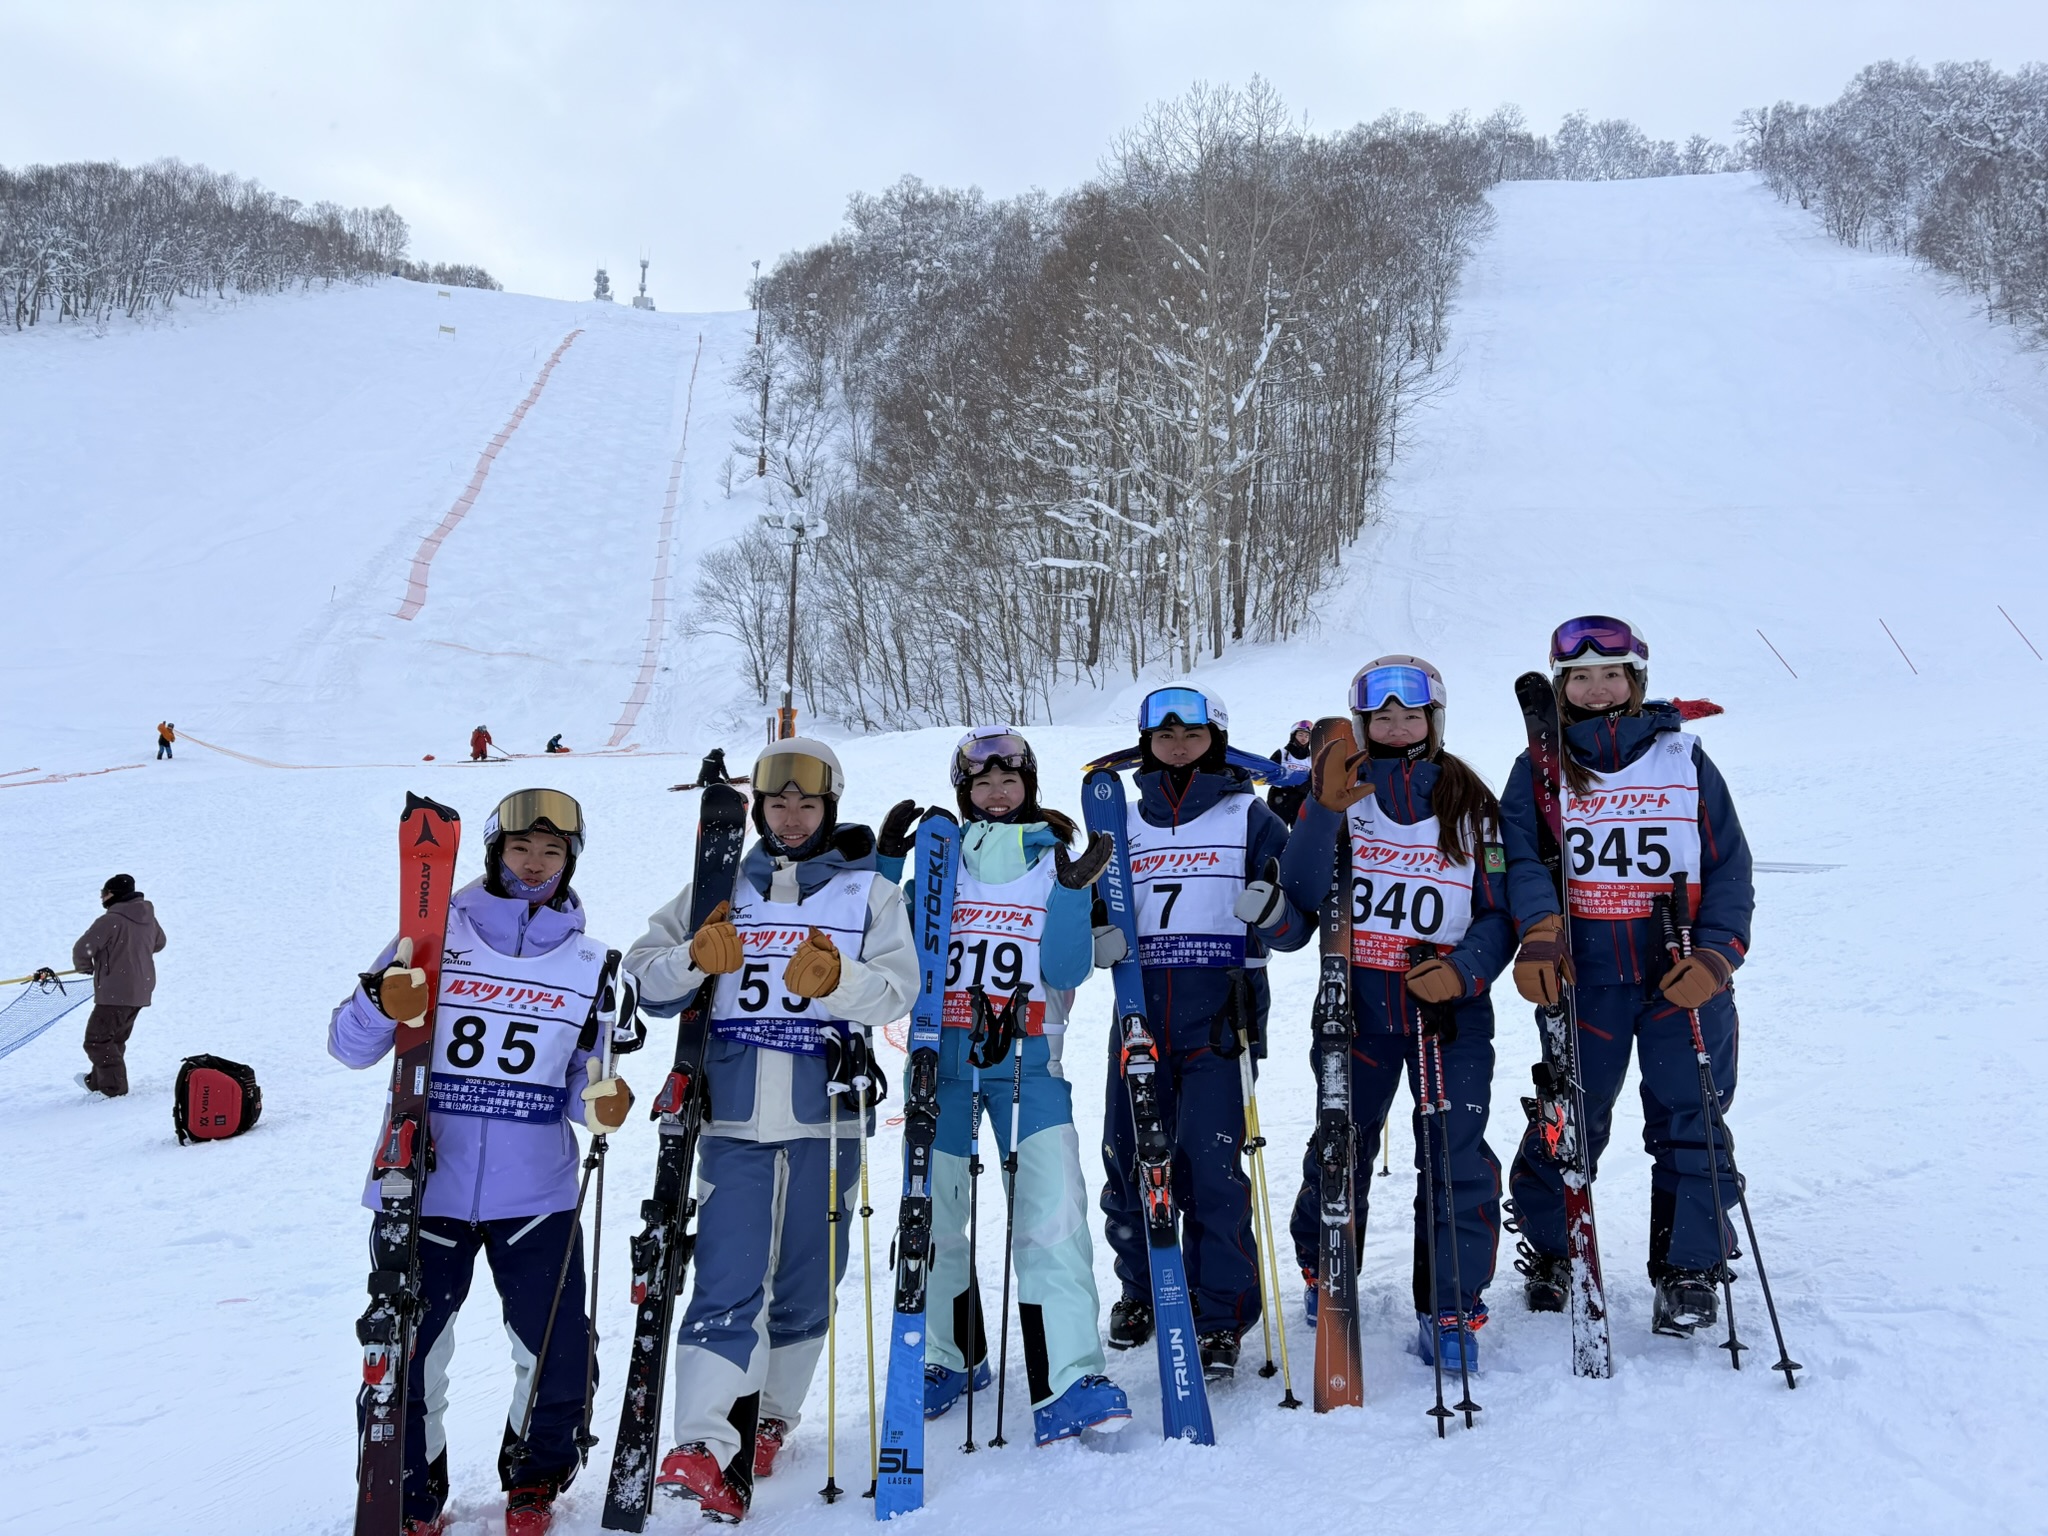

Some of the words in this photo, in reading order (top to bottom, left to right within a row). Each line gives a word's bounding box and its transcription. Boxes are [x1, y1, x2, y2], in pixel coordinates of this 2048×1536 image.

[1610, 793, 1670, 810] リゾート
[1131, 854, 1167, 875] ルスツ
[1168, 851, 1220, 867] リゾート
[1353, 845, 1400, 866] ルスツ
[1401, 852, 1450, 872] リゾート
[1565, 826, 1671, 877] 345
[418, 861, 431, 919] ATOMIC
[924, 832, 945, 956] STÖCKLI
[1152, 883, 1182, 930] 7
[1352, 876, 1444, 935] 340
[985, 910, 1034, 927] リゾート
[945, 939, 1023, 991] 319
[444, 979, 503, 1003] ルスツ
[505, 987, 566, 1009] リゾート
[915, 1016, 938, 1027] SL
[446, 1015, 539, 1075] 85
[971, 1094, 979, 1138] UNOFFICIAL
[1169, 1328, 1191, 1402] TRIUN
[878, 1448, 924, 1475] SL
[887, 1476, 912, 1485] LASER
